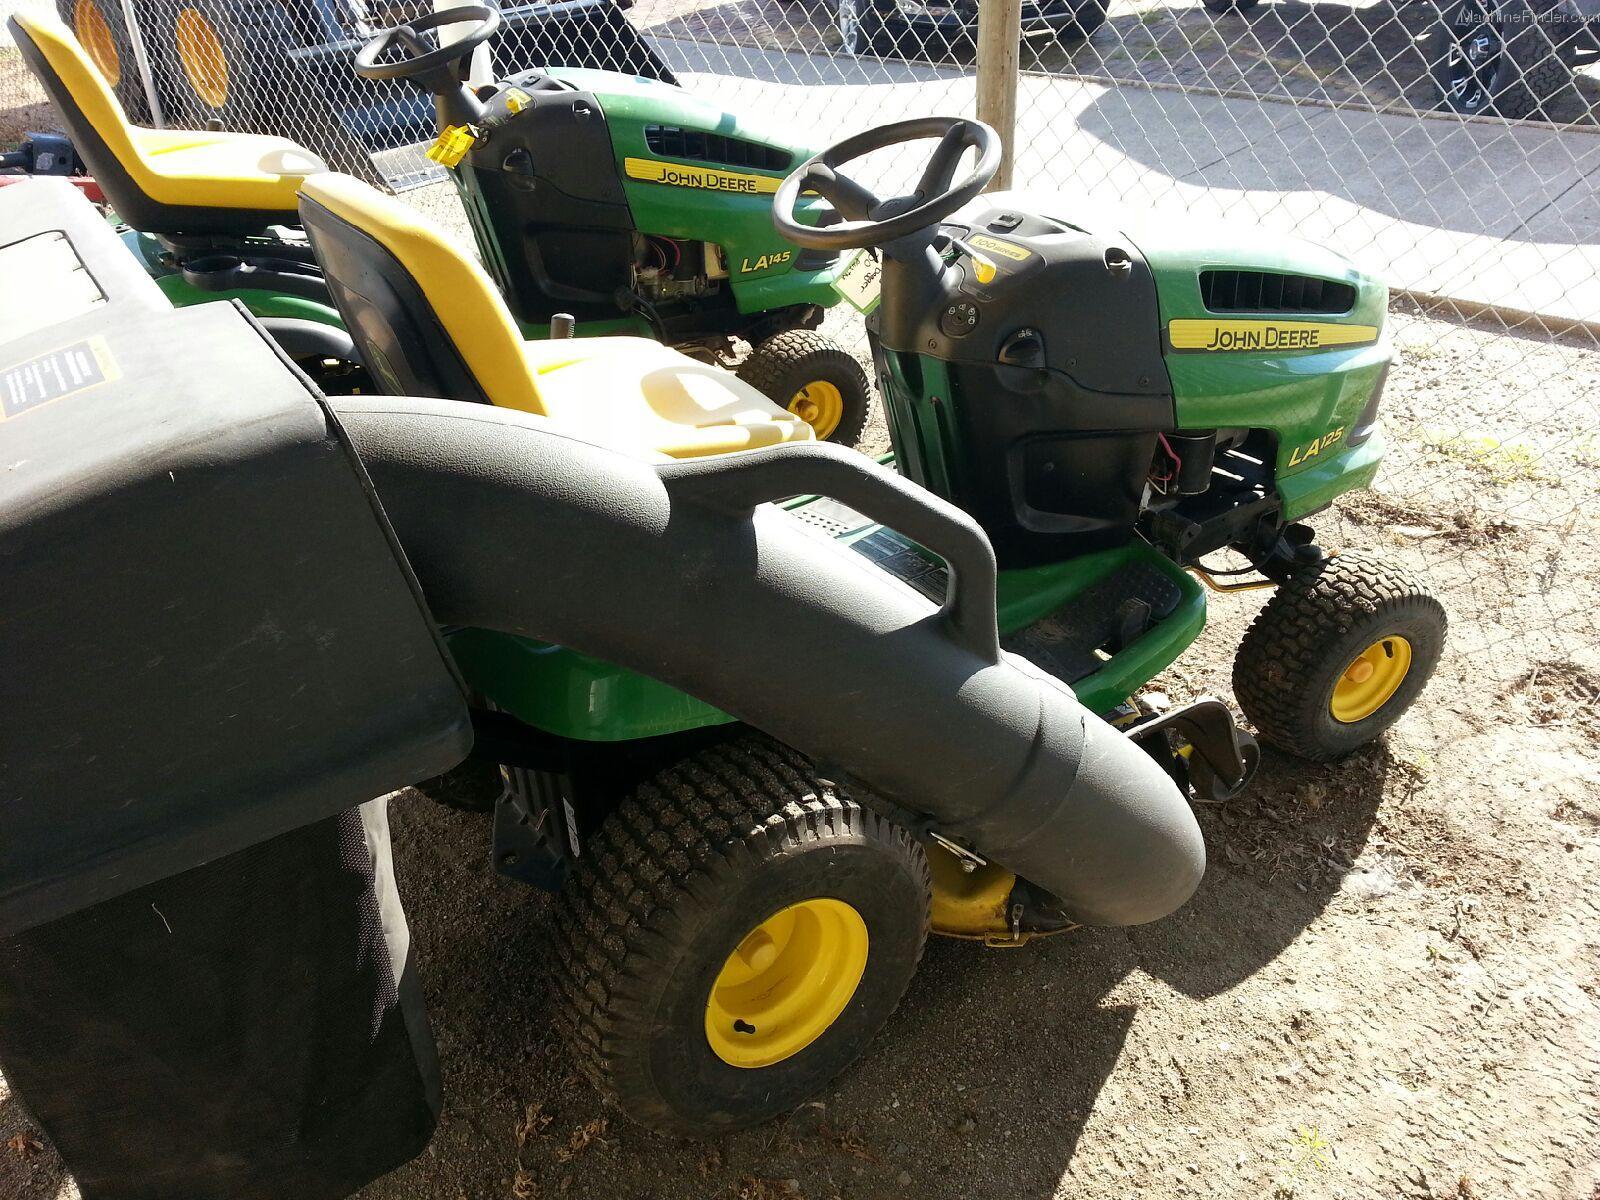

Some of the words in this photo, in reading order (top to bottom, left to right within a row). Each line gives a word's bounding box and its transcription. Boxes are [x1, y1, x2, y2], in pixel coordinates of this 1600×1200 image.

[657, 168, 702, 187] JOHN
[706, 174, 757, 191] DEERE
[741, 251, 791, 273] LA145
[1207, 328, 1261, 348] JOHN
[1265, 327, 1319, 347] DEERE
[1288, 426, 1345, 468] LA125
